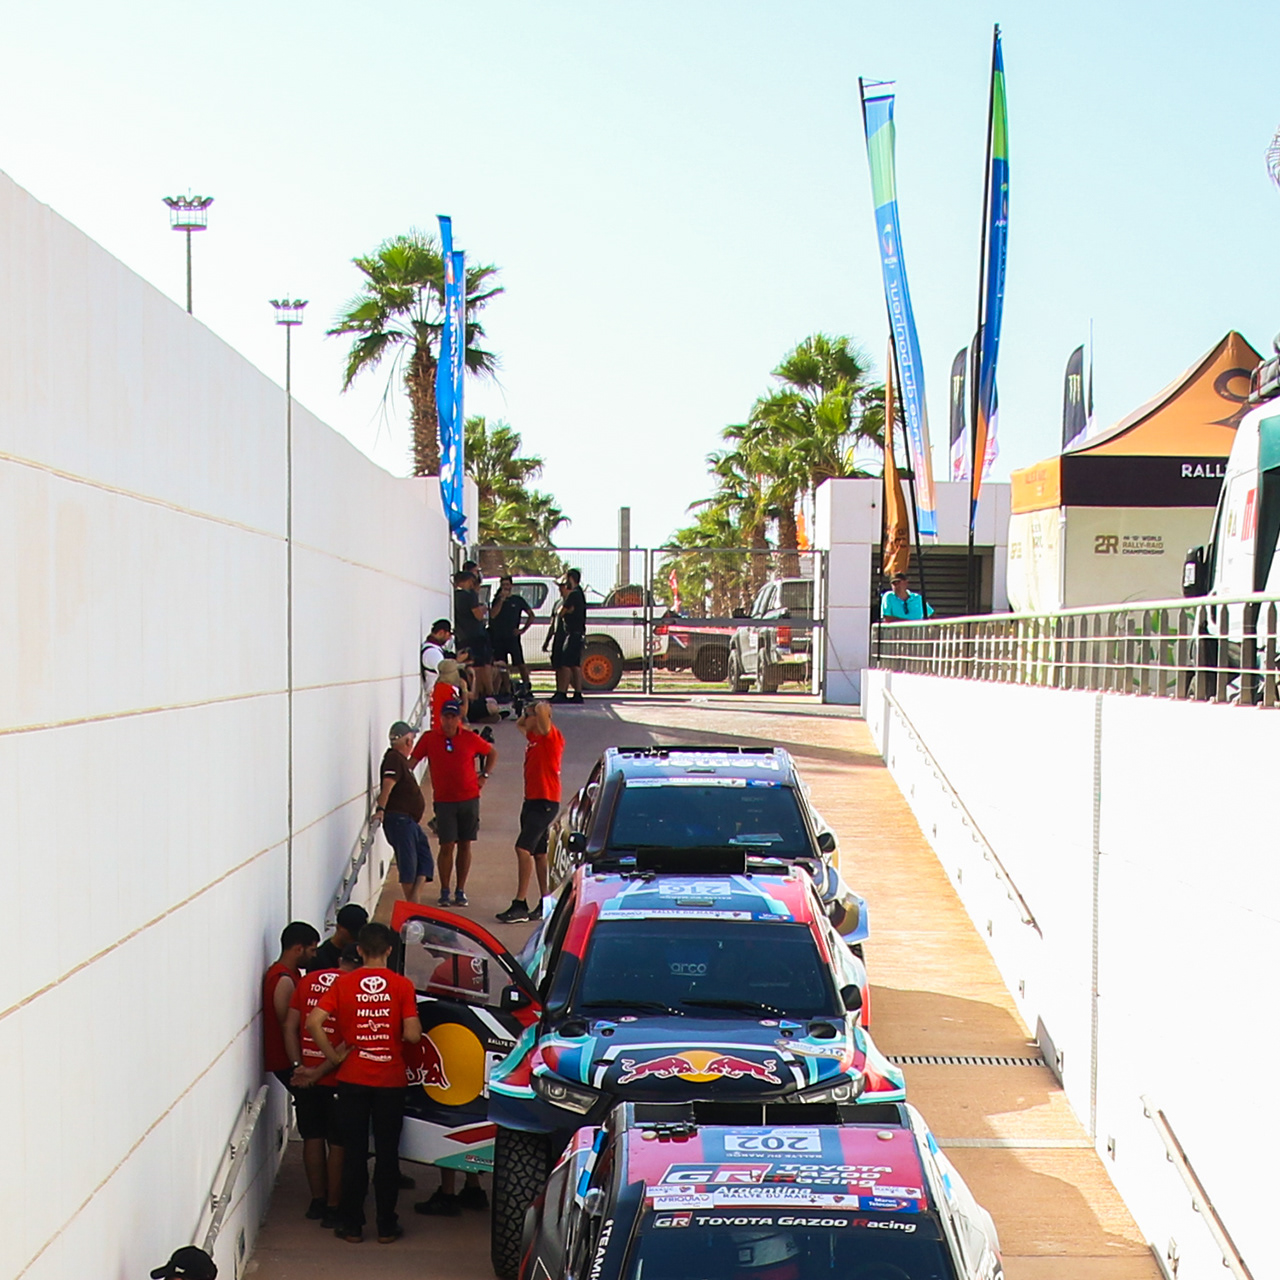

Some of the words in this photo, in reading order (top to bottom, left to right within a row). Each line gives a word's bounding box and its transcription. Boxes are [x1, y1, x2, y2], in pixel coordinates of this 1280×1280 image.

[1094, 534, 1119, 554] 2R
[356, 993, 391, 1003] TOYOTA
[357, 1008, 390, 1018] HILUX
[737, 1136, 809, 1151] 202
[779, 1164, 893, 1173] TOYOTA
[665, 1170, 760, 1183] GR
[714, 1185, 812, 1196] Argentina
[655, 1218, 690, 1227] GR
[695, 1216, 773, 1226] TOYOTA
[777, 1217, 848, 1227] GAZOO
[852, 1218, 917, 1233] Racing
